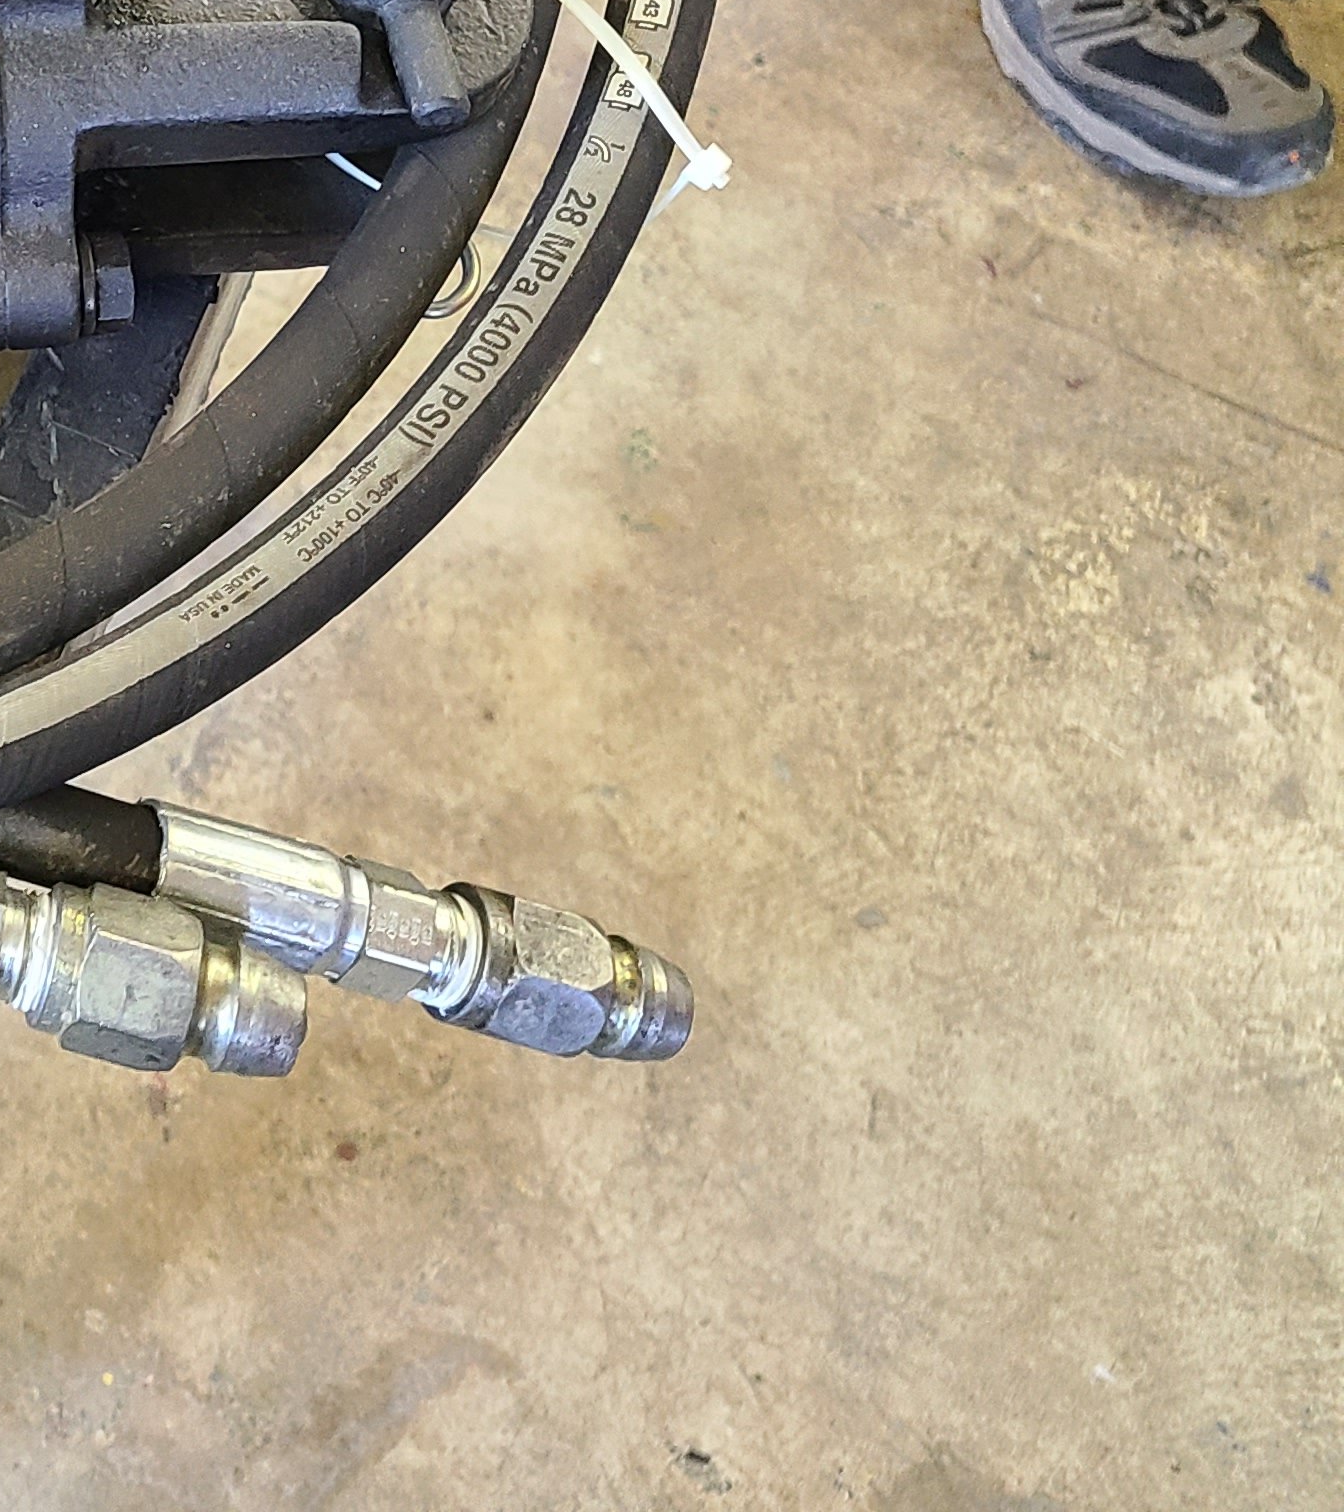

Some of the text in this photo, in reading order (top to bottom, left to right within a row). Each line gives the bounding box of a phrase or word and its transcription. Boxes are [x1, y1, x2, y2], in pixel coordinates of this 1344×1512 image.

[642, 0, 660, 18] 43
[616, 78, 635, 98] 48
[396, 187, 598, 450] 28 MPa (4000 PSI)
[327, 486, 350, 505] TO
[345, 501, 372, 524] TO
[221, 563, 264, 595] MADE
[178, 597, 213, 624] USA
